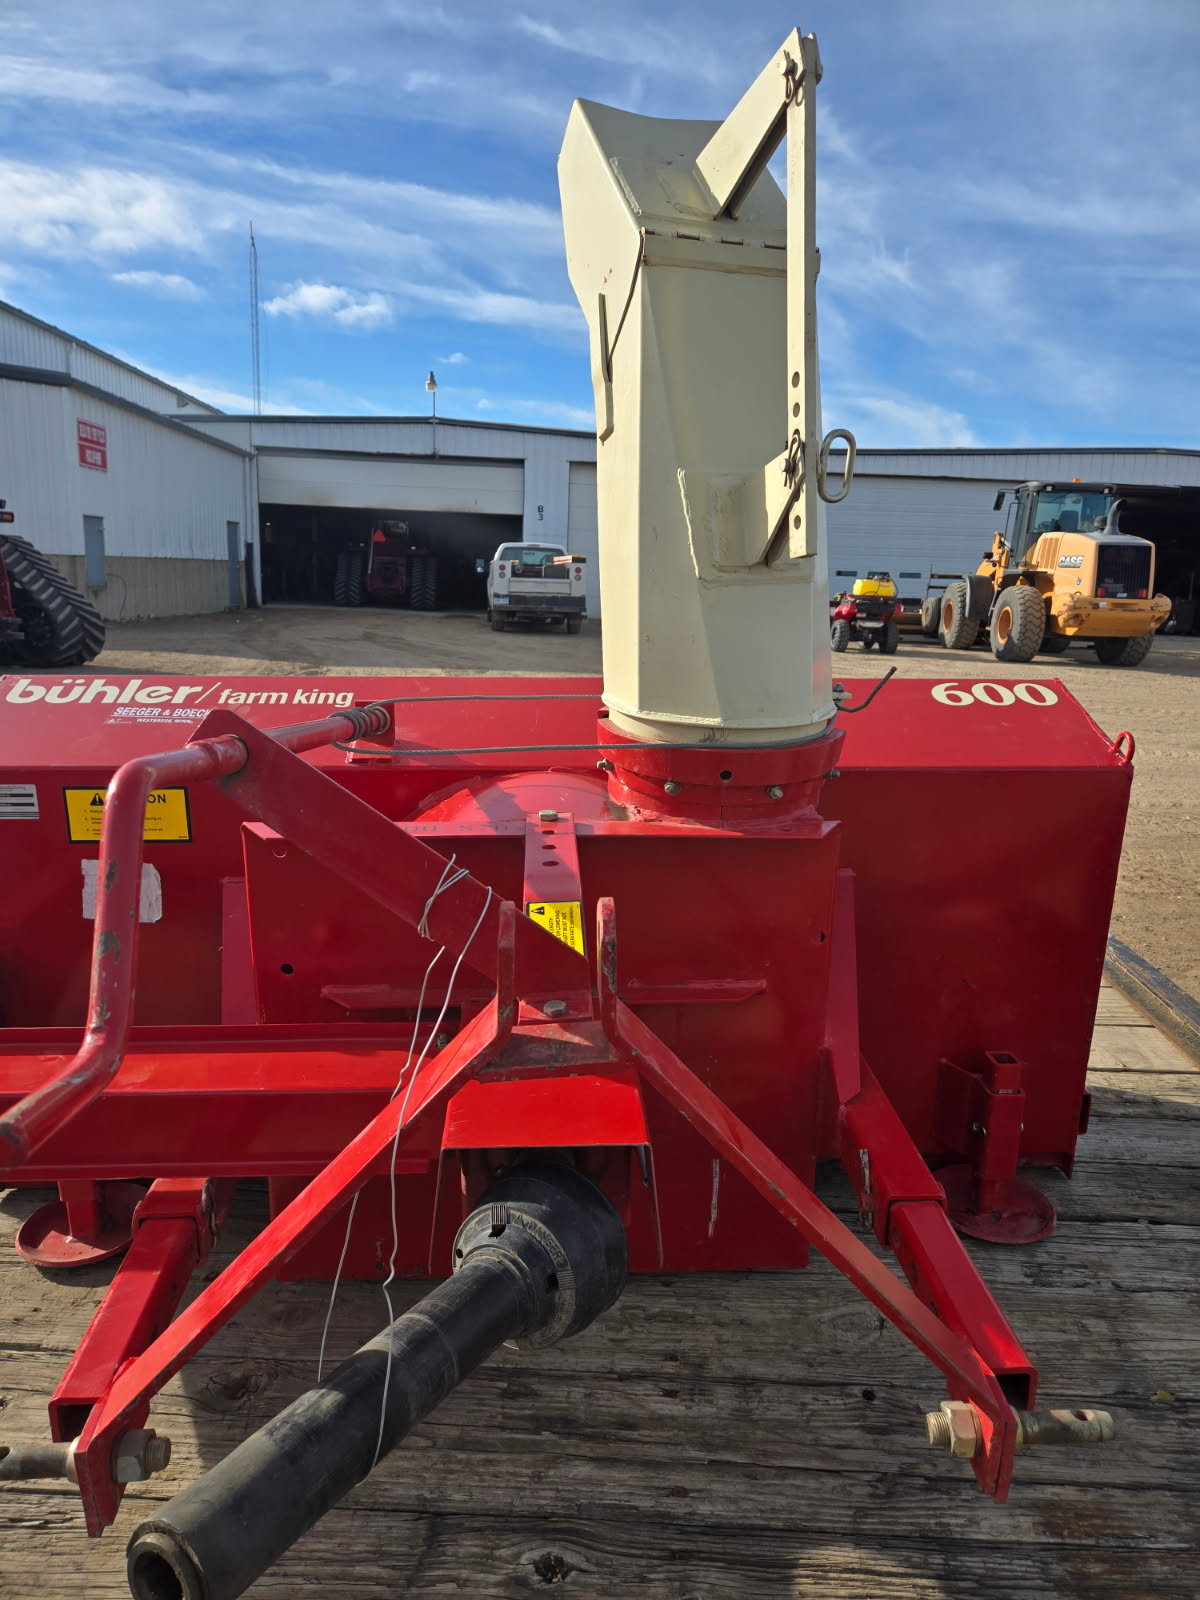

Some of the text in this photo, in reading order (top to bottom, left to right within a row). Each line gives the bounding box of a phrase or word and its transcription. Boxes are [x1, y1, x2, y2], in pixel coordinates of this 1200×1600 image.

[1058, 554, 1084, 568] CASE
[217, 688, 289, 705] farm
[292, 688, 354, 708] king
[930, 682, 1059, 706] 600
[114, 707, 162, 716] SEEGER
[526, 1221, 564, 1265] DANGER
